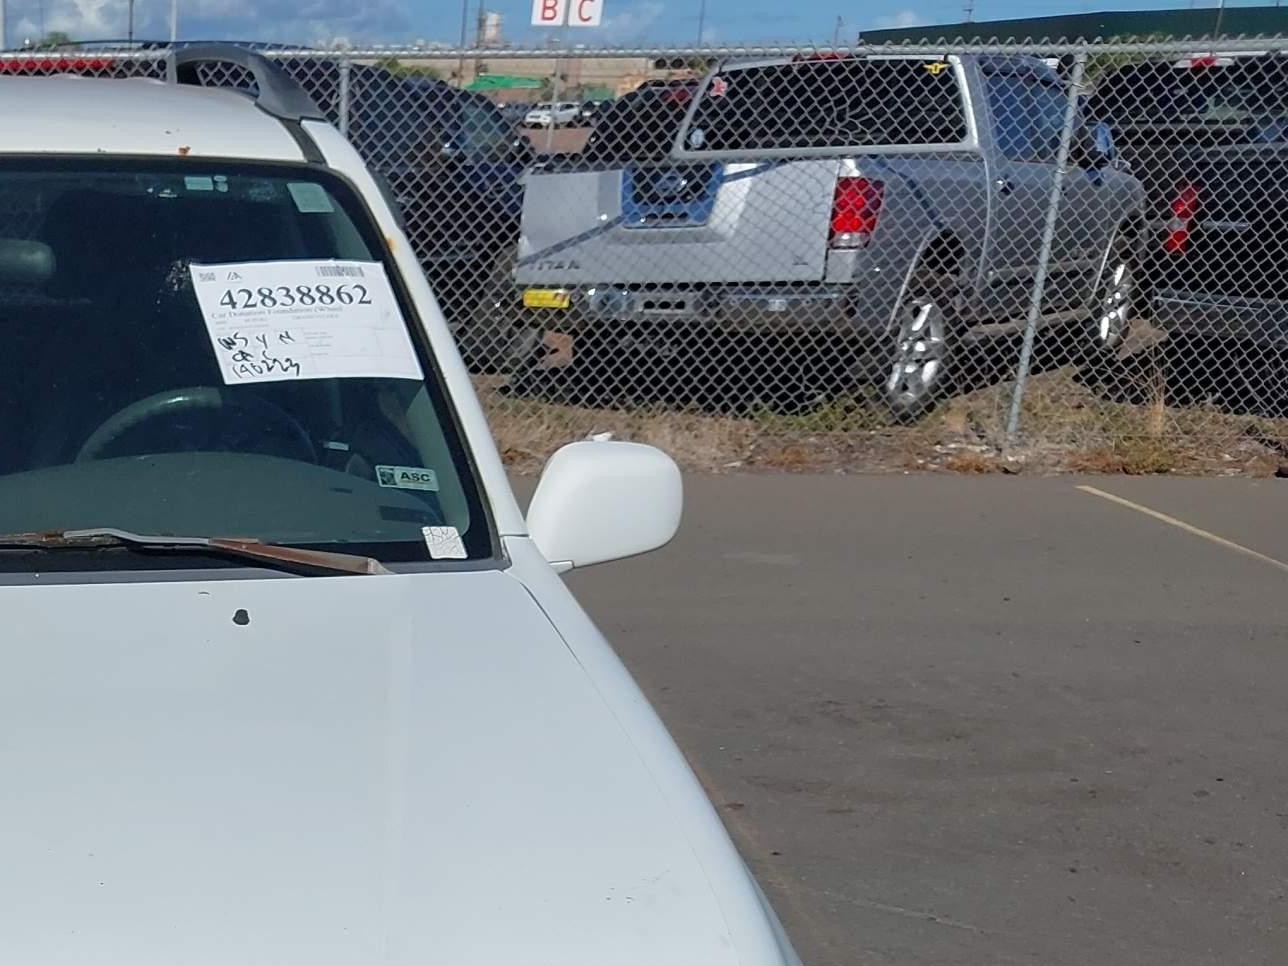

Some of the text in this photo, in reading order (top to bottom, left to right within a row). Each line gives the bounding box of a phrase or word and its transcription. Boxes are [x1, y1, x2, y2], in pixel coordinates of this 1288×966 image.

[542, 0, 558, 21] B
[578, 0, 594, 22] C
[220, 285, 372, 310] 42838862
[400, 471, 431, 481] ASC
